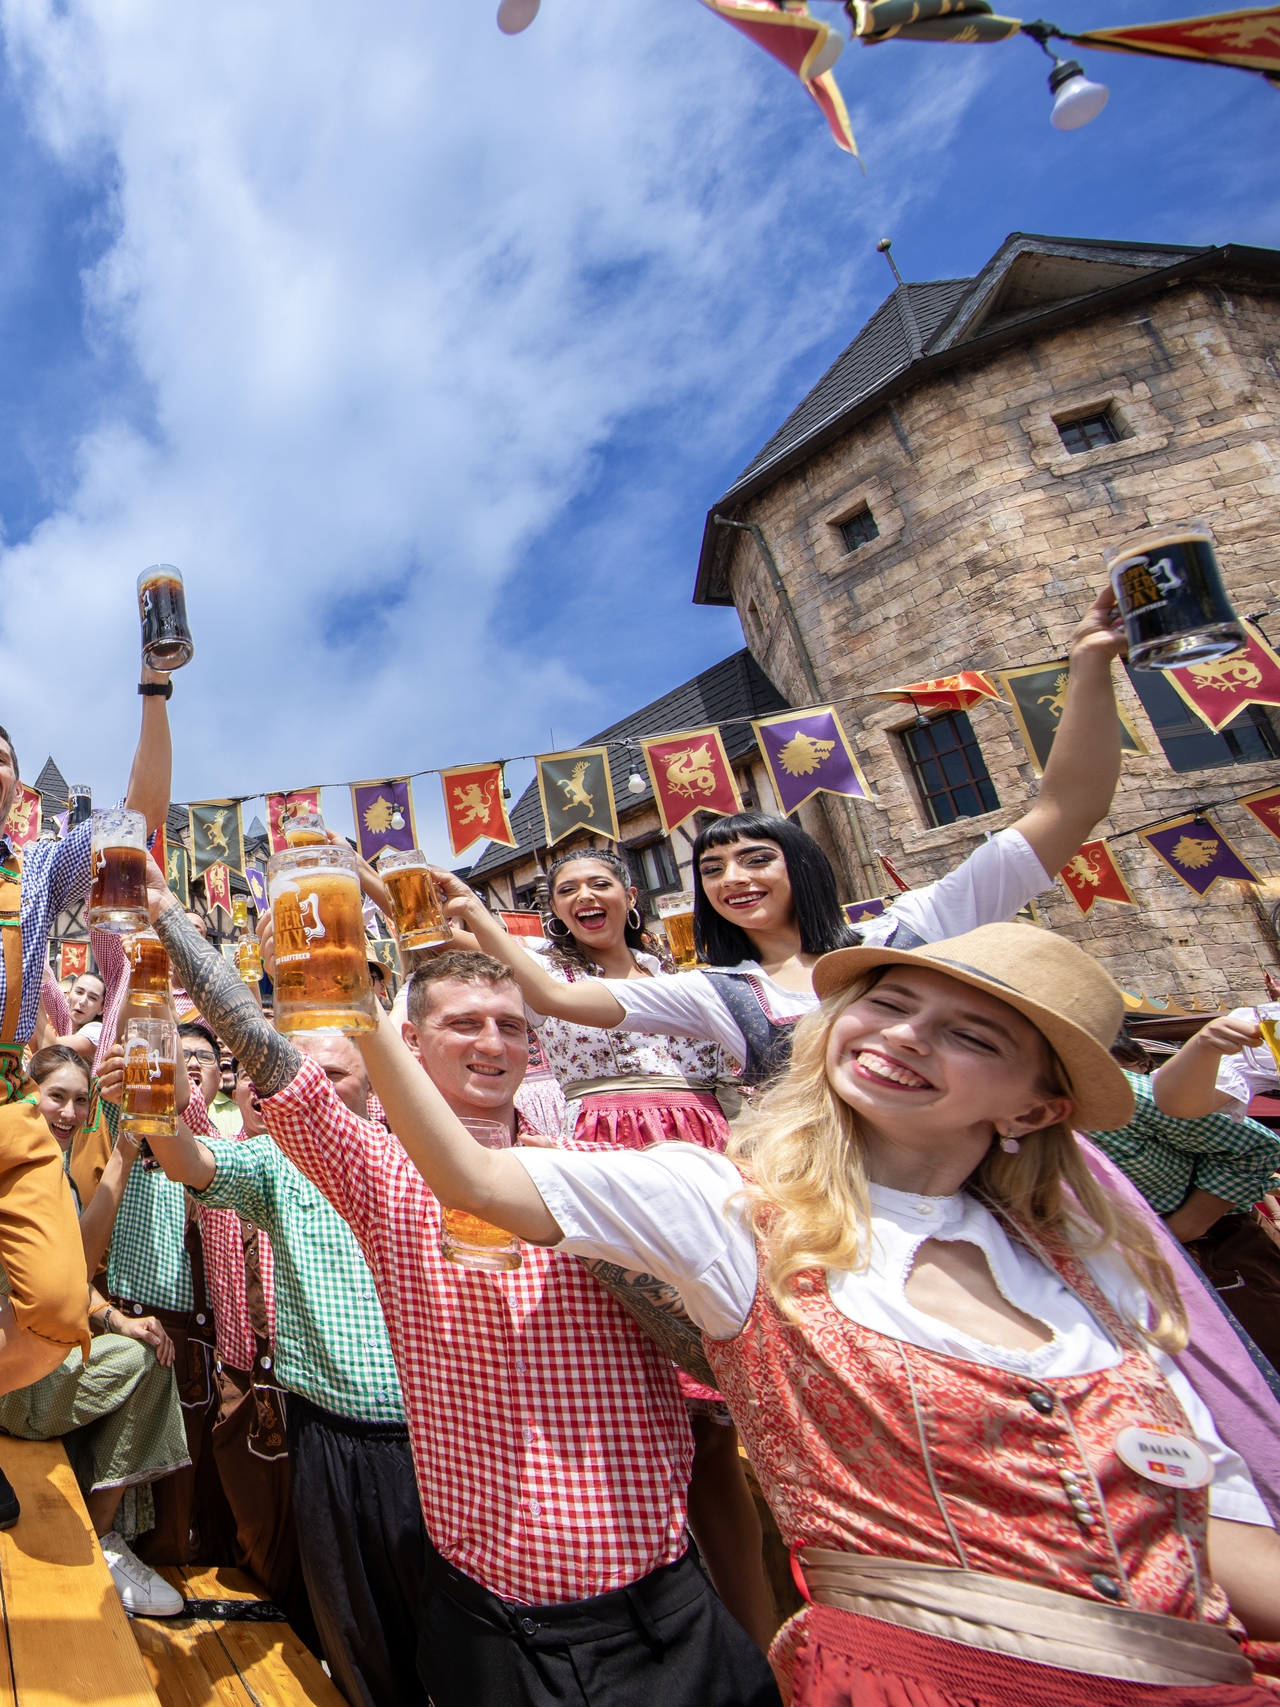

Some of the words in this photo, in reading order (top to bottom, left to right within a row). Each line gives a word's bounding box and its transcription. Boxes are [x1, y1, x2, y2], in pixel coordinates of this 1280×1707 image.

[1123, 586, 1160, 612] DAY
[275, 928, 304, 952] DAY
[126, 1068, 149, 1083] DAY
